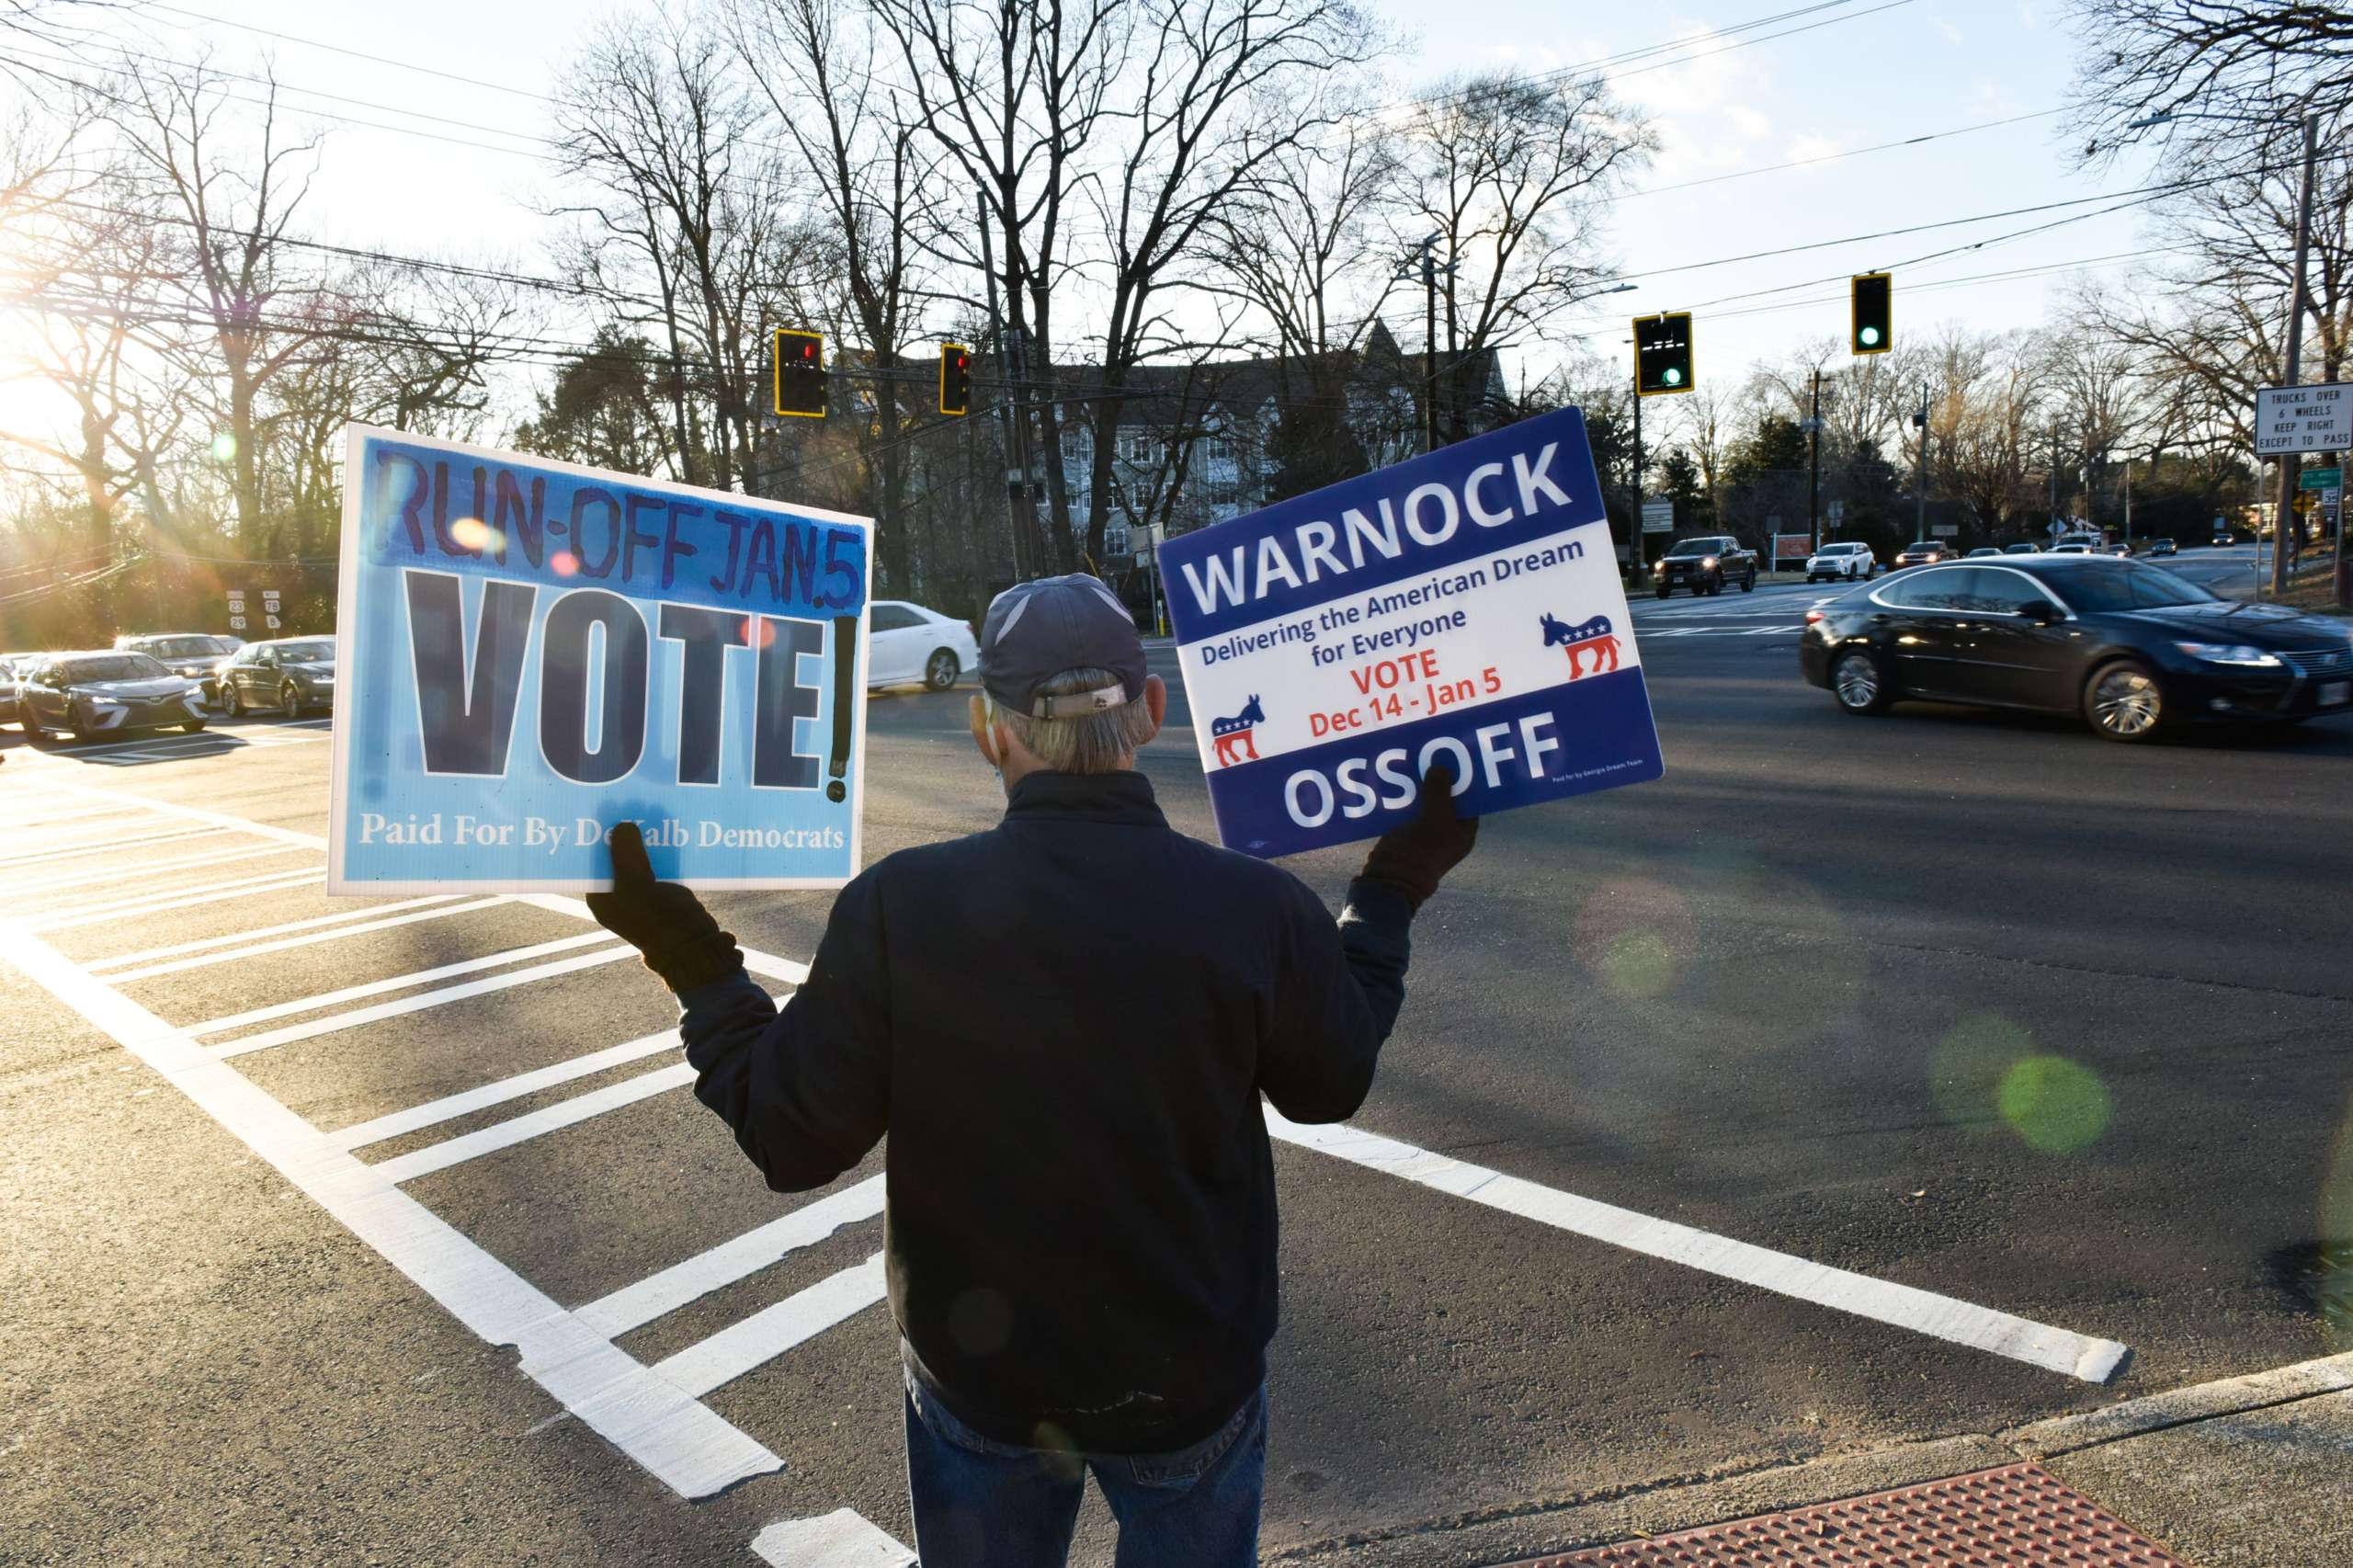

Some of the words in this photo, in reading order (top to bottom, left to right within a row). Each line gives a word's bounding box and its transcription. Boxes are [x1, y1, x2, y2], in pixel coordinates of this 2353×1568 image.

[2271, 392, 2307, 404] TRUCKS
[2316, 390, 2340, 401] OVER
[2279, 409, 2285, 418] 6
[2295, 405, 2331, 417] WHEELS
[2259, 437, 2292, 449] EXCEPT
[2302, 436, 2313, 446] TO
[2324, 434, 2349, 444] PASS
[2274, 422, 2296, 433] KEEP
[2307, 419, 2335, 431] RIGHT
[375, 449, 704, 583] RUN-OFF
[1181, 441, 1573, 616] WARNOCK
[1201, 619, 1316, 666] Delivering
[1320, 603, 1360, 632] the
[1367, 567, 1486, 619] American
[1493, 540, 1584, 581] Dream
[1311, 643, 1345, 667] for
[1353, 608, 1467, 657] Everyone
[1350, 648, 1440, 695] VOTE
[1309, 705, 1362, 737] Dec
[1370, 692, 1403, 722] 14
[1427, 676, 1476, 716] Jan
[1483, 666, 1502, 693] 5
[1284, 711, 1559, 828] OSSOFF
[359, 812, 443, 845] Paid
[453, 815, 515, 846] For
[523, 816, 567, 855] By
[574, 817, 688, 847] Dealb
[699, 820, 845, 849] Democrats
